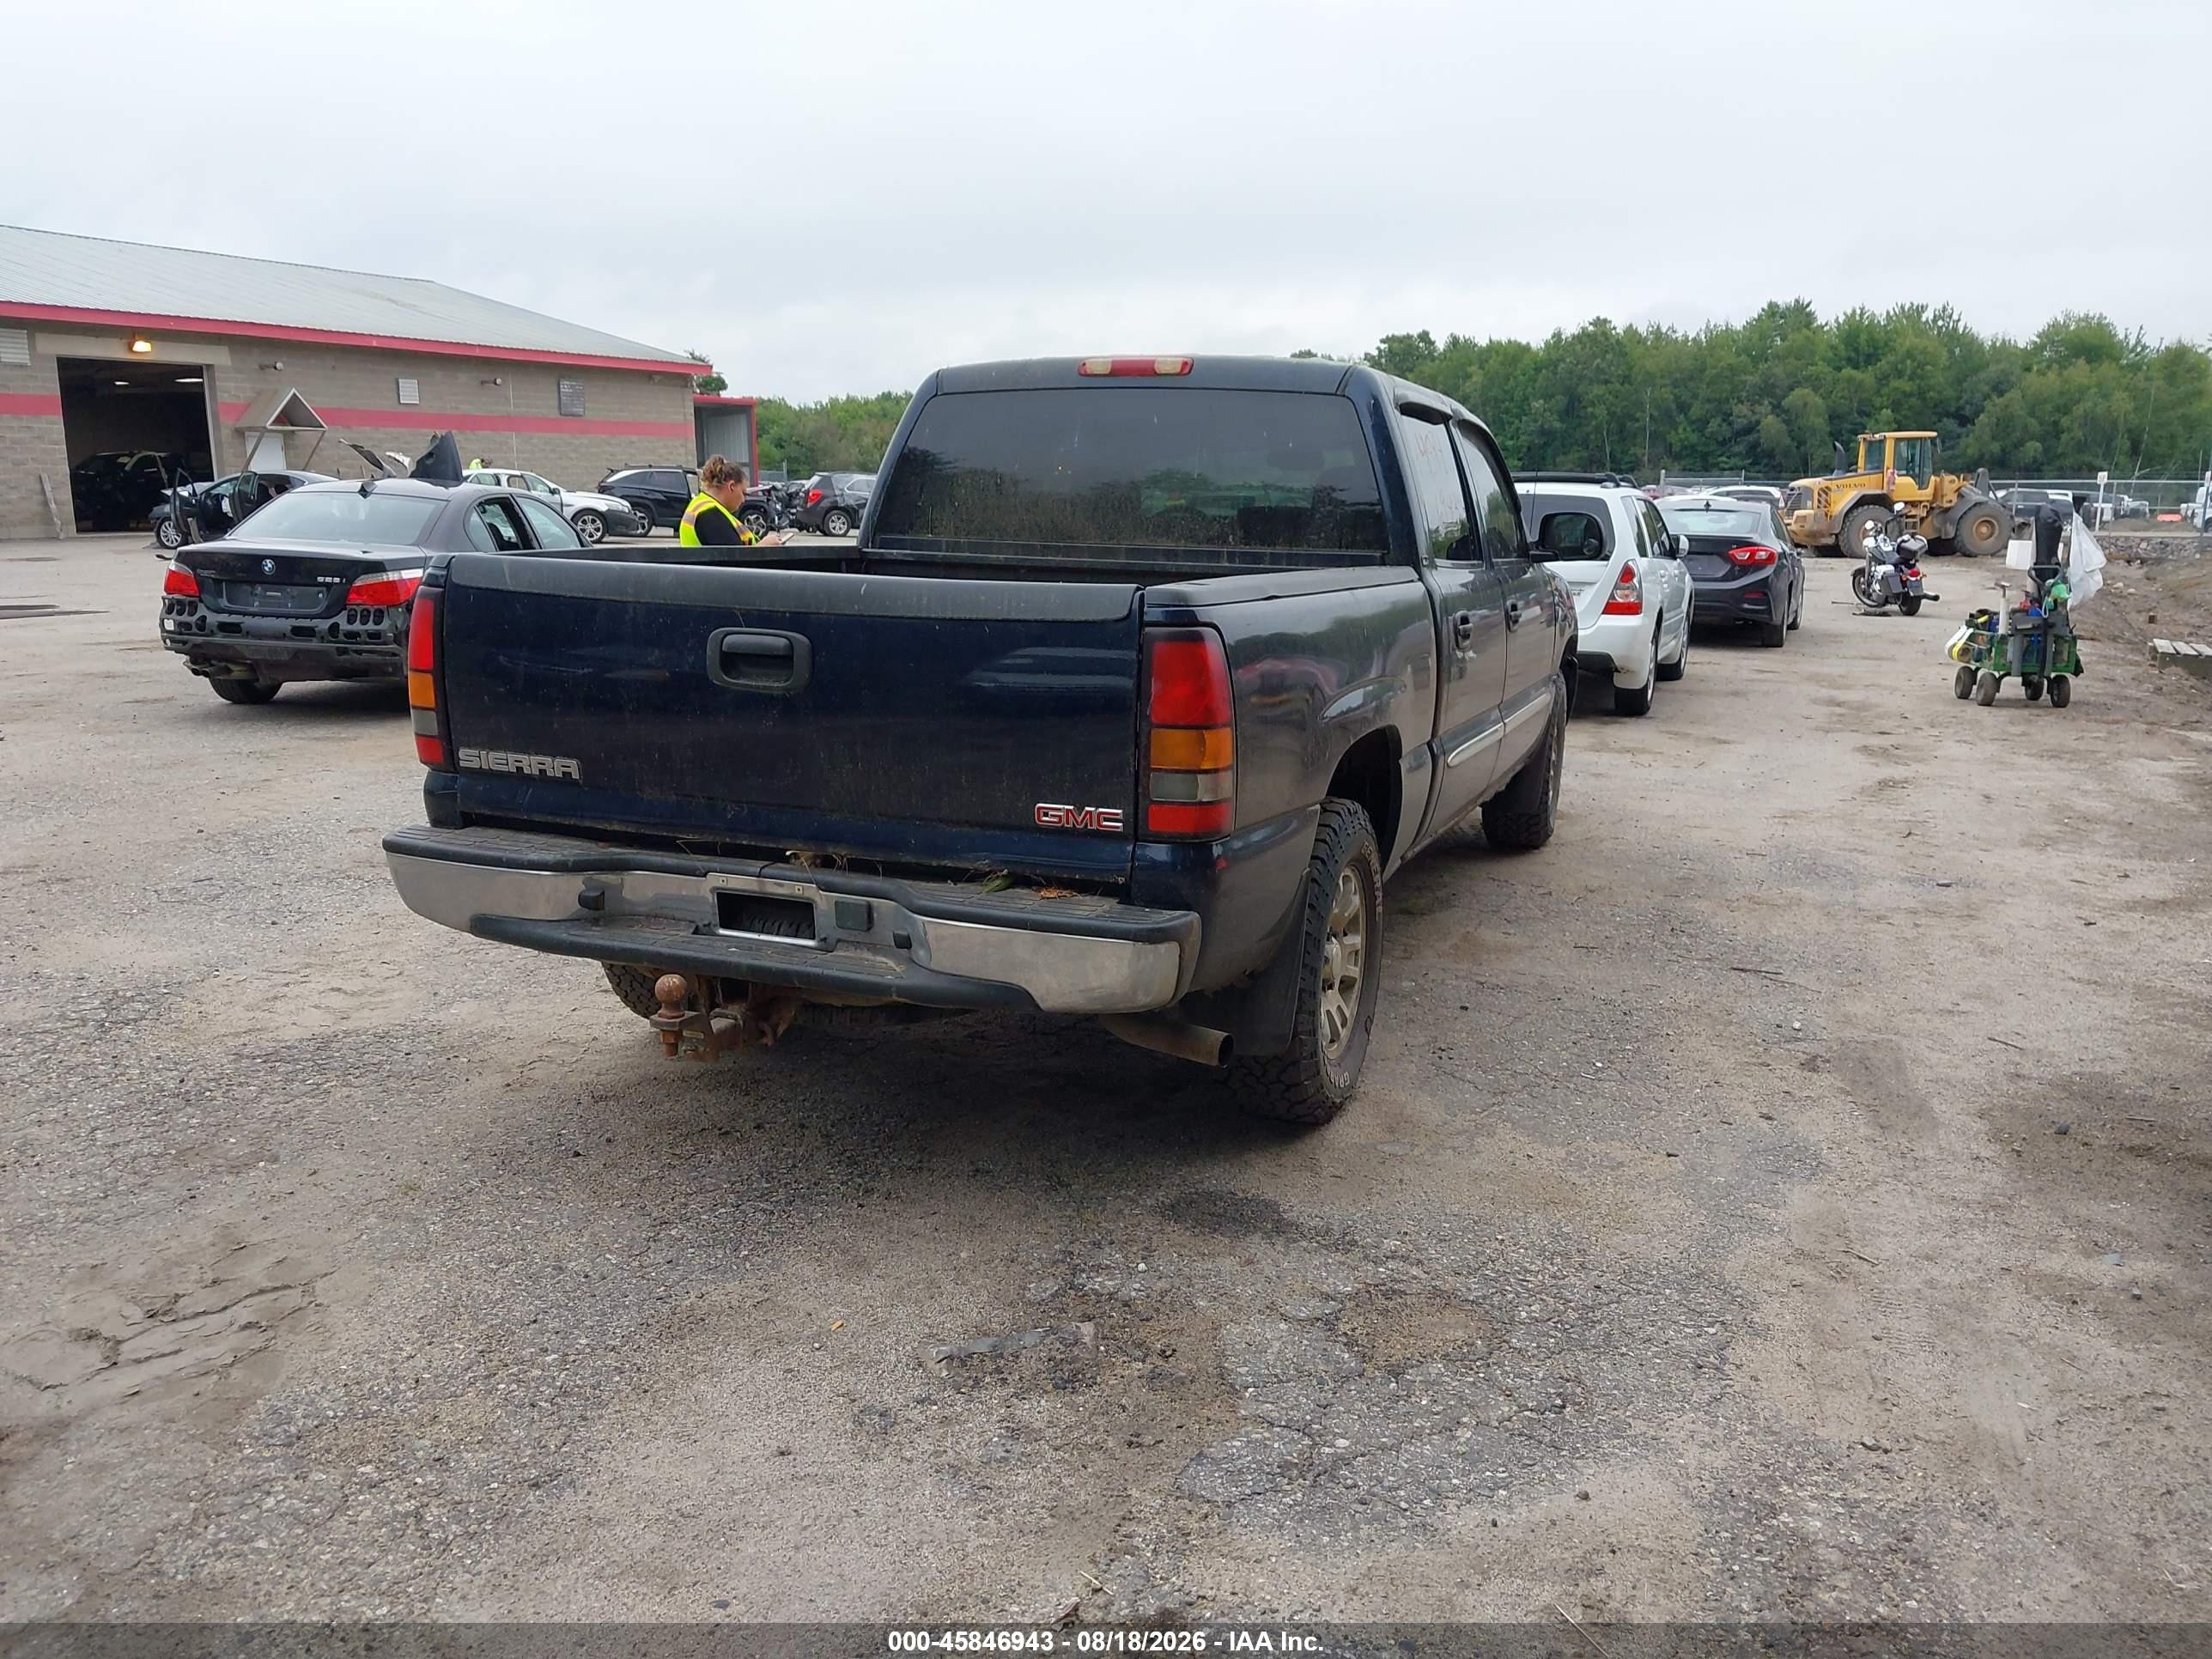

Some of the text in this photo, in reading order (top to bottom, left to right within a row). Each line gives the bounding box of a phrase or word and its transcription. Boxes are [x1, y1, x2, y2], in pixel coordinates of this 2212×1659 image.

[458, 749, 580, 780] SIERRA
[1035, 803, 1123, 832] GMC
[1361, 841, 1383, 921] GENERAL
